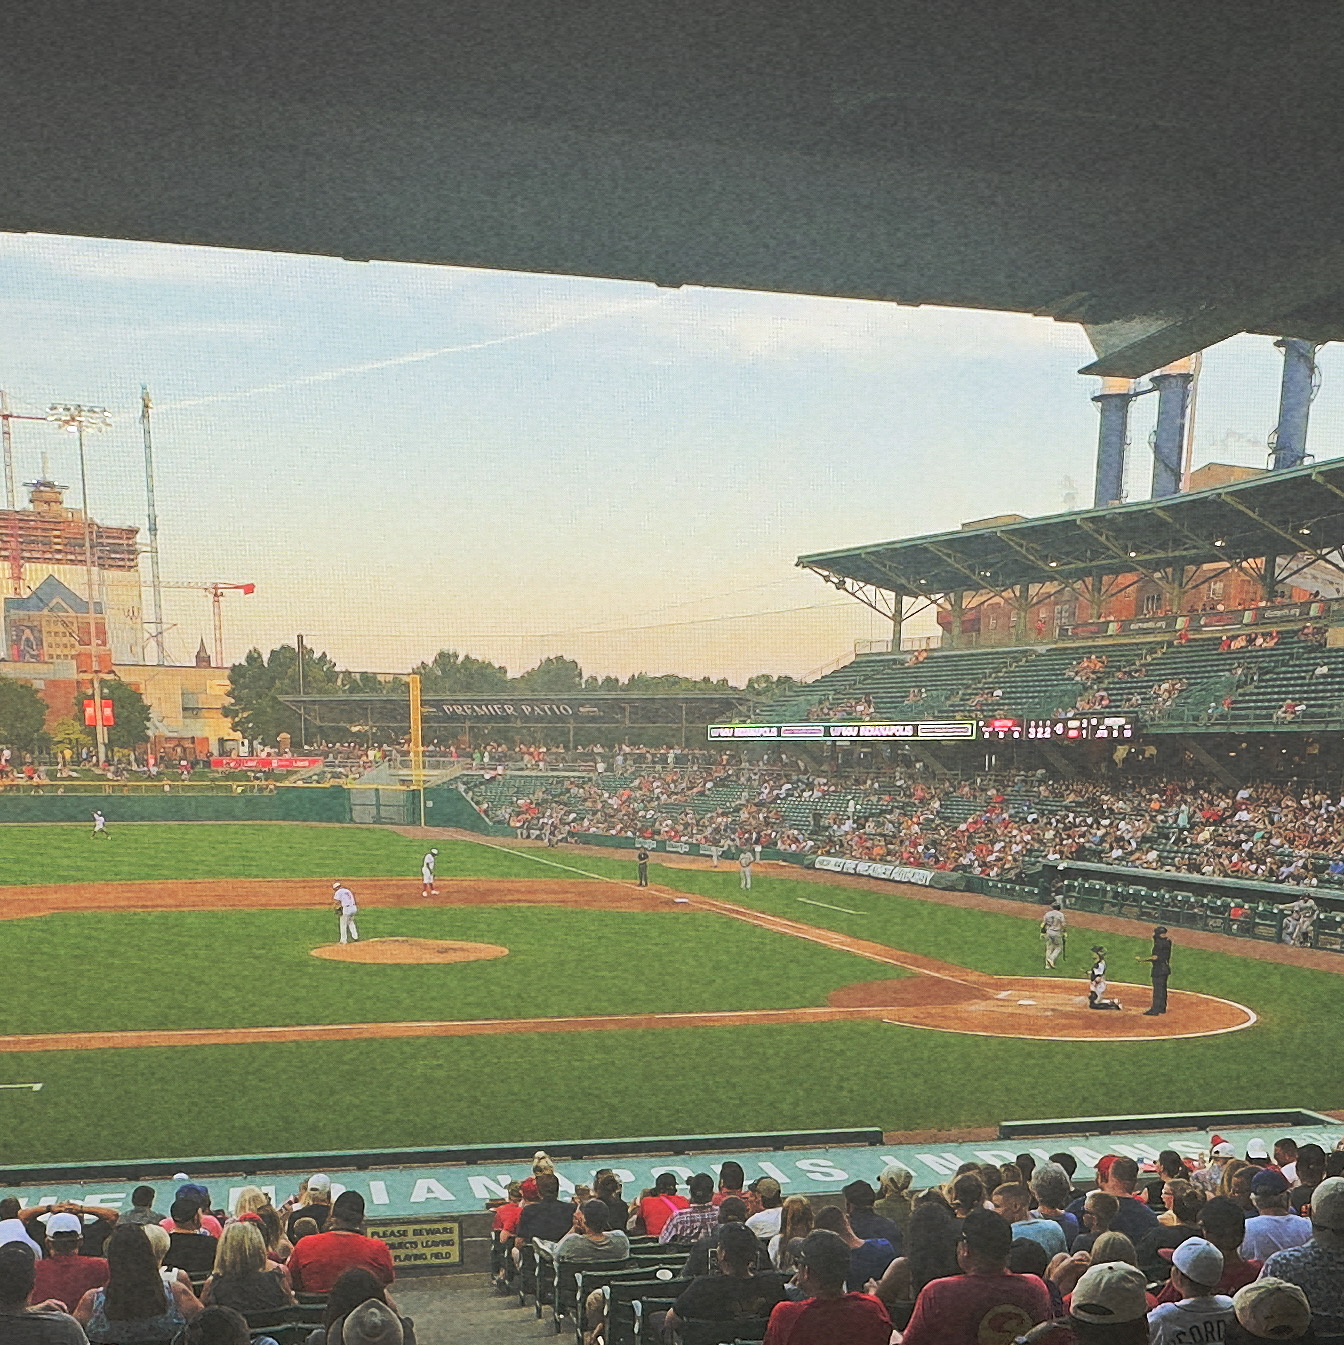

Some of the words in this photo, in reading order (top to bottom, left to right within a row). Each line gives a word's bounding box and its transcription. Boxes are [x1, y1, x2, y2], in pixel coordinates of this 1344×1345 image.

[443, 704, 518, 716] PREMIER
[521, 704, 574, 716] PATIO
[371, 1229, 409, 1239] PLEASE
[412, 1227, 454, 1237] BEWARE
[421, 1239, 455, 1248] LEAVING
[394, 1252, 427, 1262] PLAYING
[430, 1251, 452, 1260] FIELD
